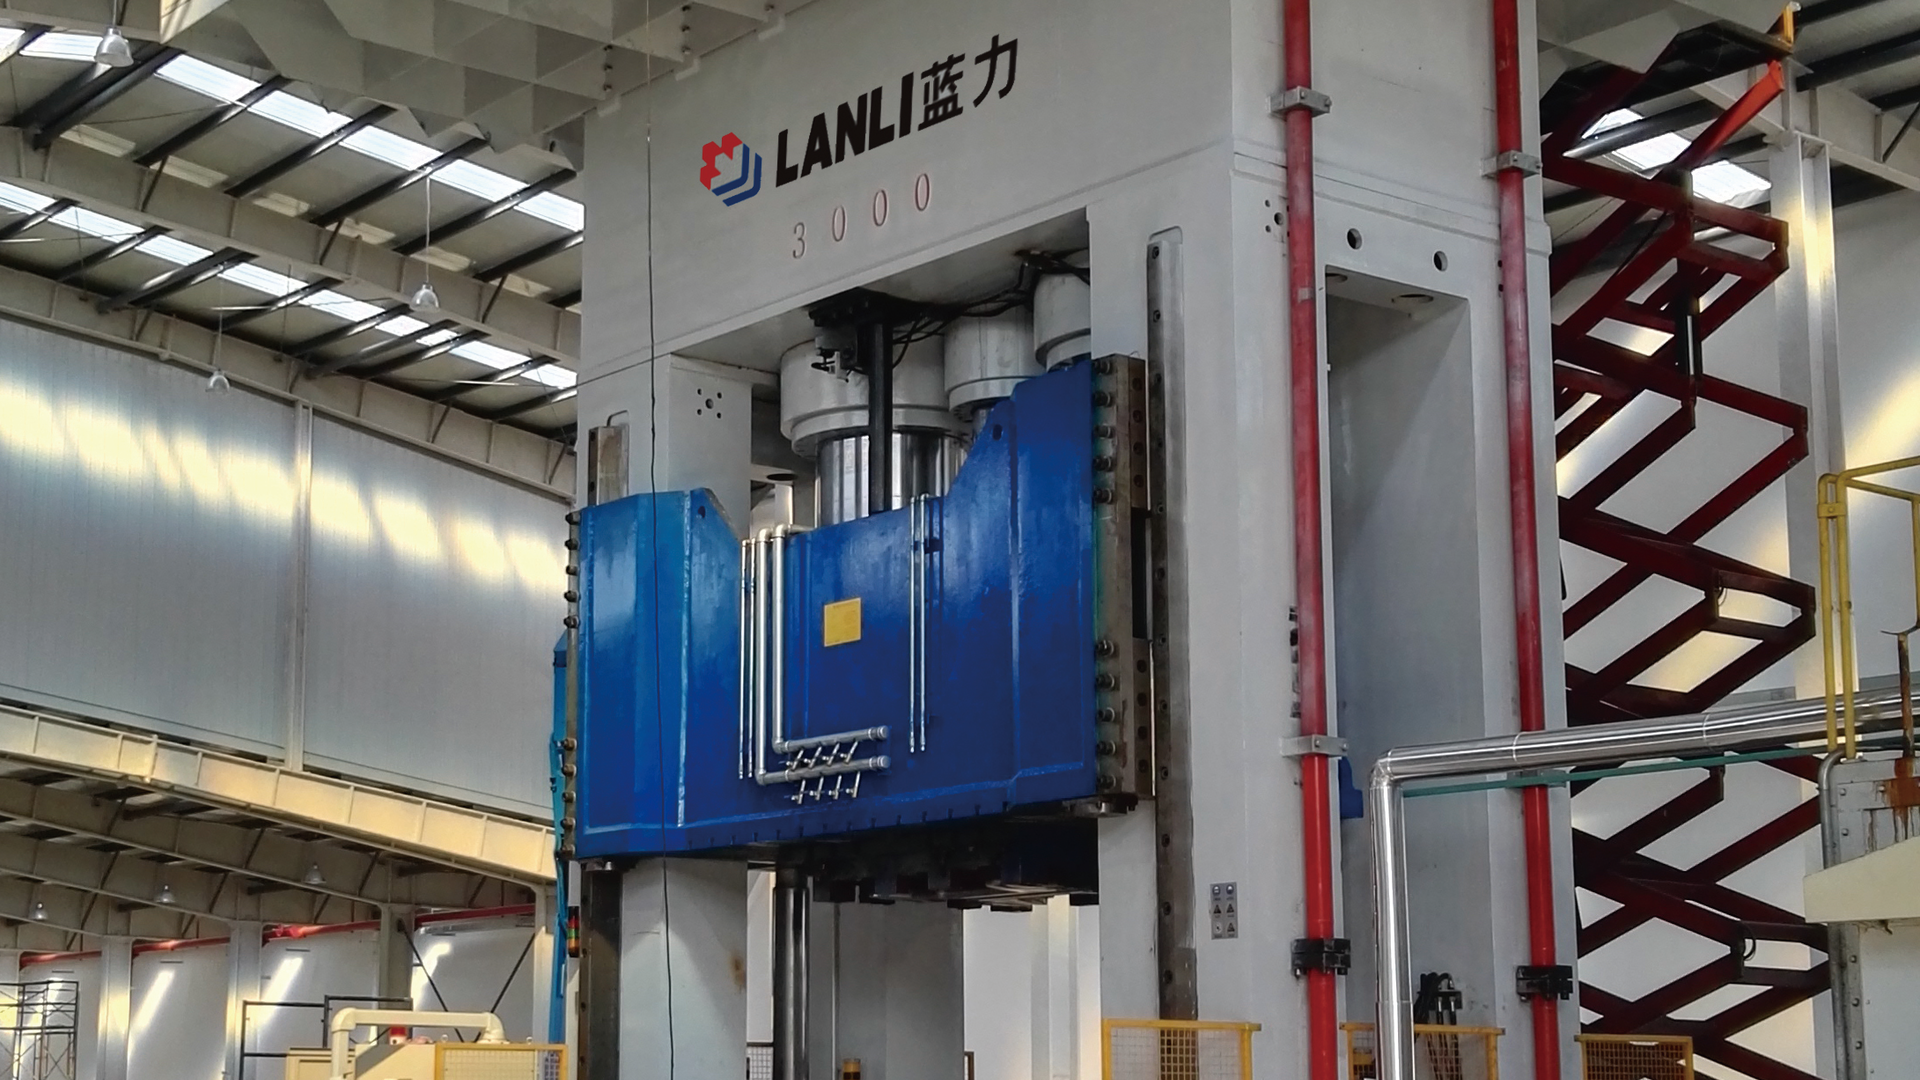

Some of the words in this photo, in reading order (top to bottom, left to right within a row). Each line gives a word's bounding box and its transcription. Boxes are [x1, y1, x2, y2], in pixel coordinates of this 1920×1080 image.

[776, 71, 914, 187] LANLI
[918, 34, 1018, 131] 蓝力
[792, 173, 931, 259] 3000
